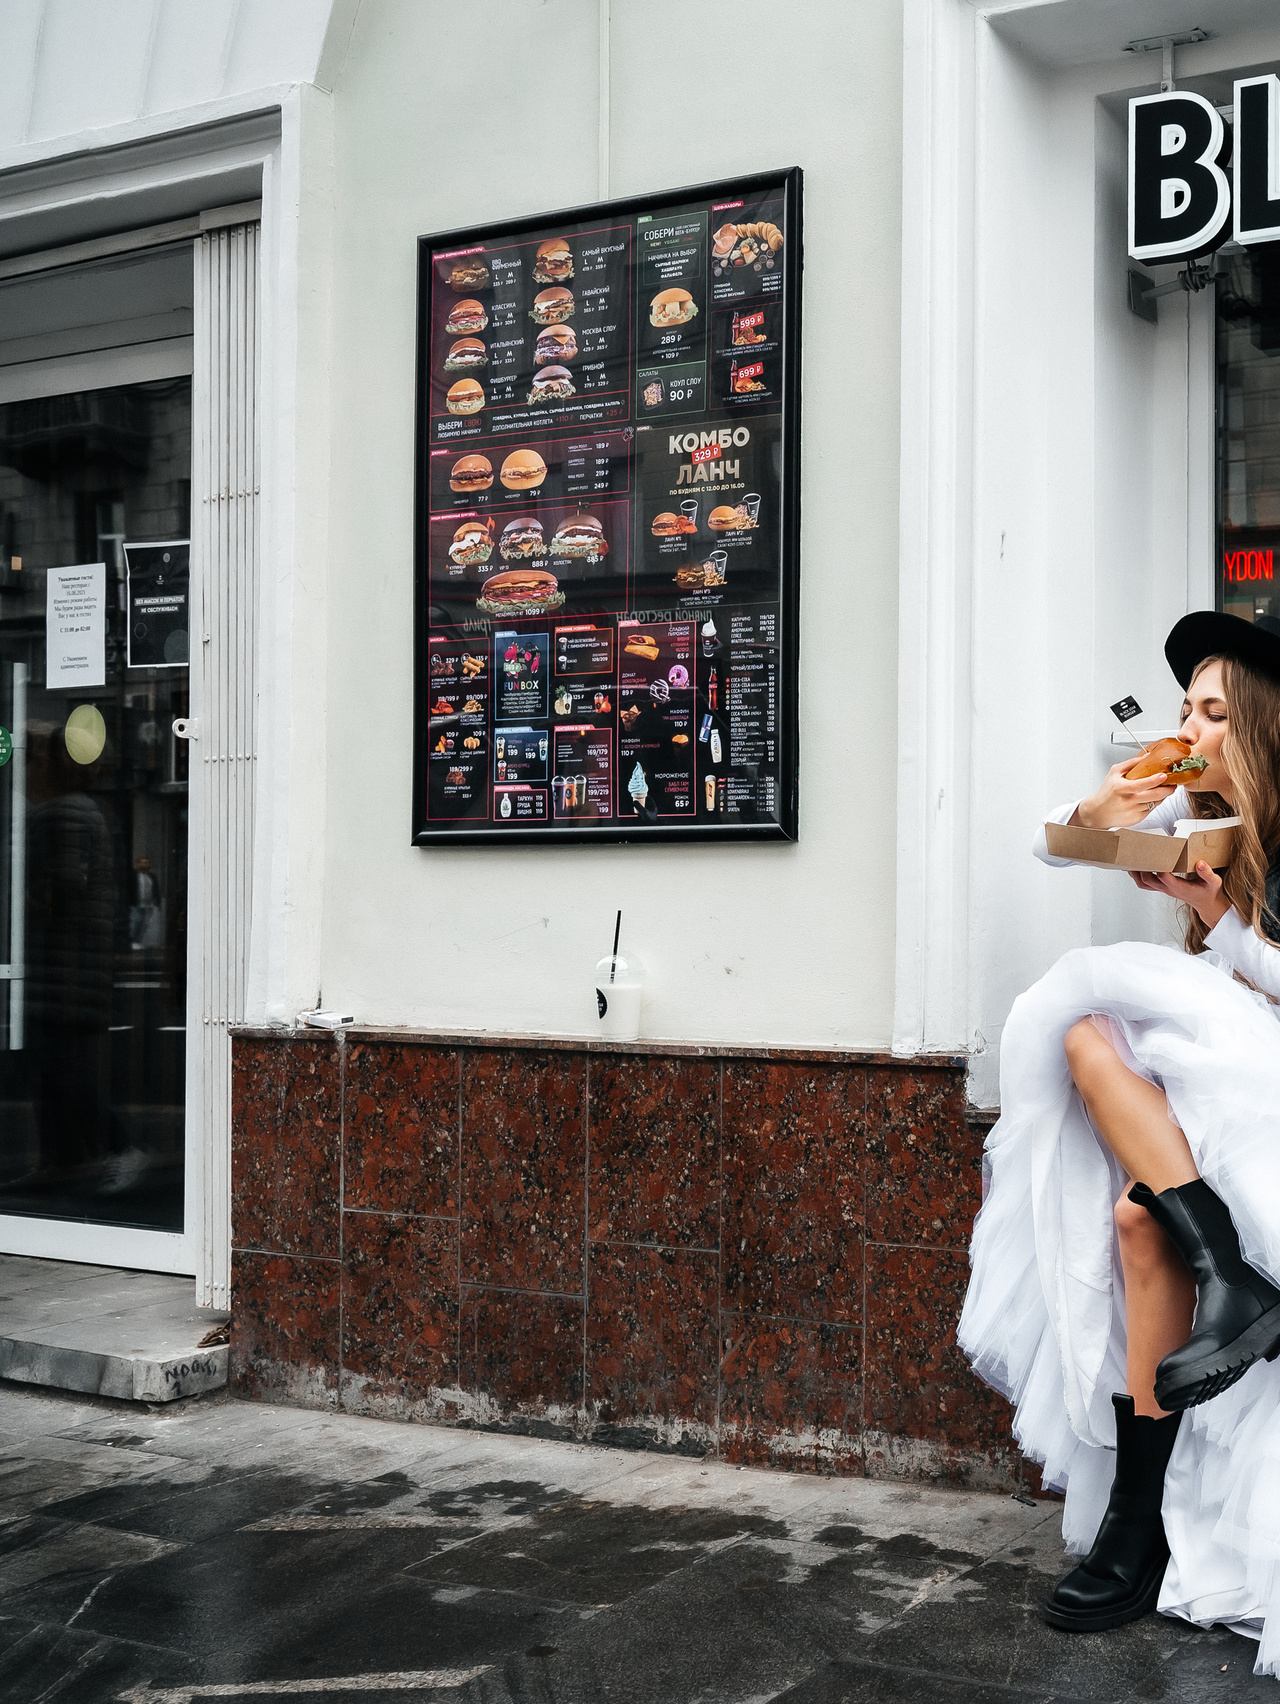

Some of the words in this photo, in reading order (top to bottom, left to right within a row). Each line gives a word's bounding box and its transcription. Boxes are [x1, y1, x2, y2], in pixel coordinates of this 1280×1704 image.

[644, 227, 674, 241] СОБЕРИ
[648, 252, 671, 261] НАЧИНКА
[740, 317, 755, 329] 599
[582, 327, 602, 336] МОСКВА
[661, 335, 676, 345] 289
[639, 370, 659, 378] САЛАТЫ
[739, 367, 755, 379] 699
[669, 380, 686, 388] КОУЛ
[686, 377, 702, 386] СЛОУ
[669, 389, 684, 402] 90
[438, 420, 463, 431] ВЫБЕРИ
[668, 426, 750, 455] КОМБО
[694, 448, 711, 462] 329
[676, 459, 740, 485] ЛАНЧ
[678, 486, 701, 495] БУДНЯМ
[1223, 550, 1273, 581] YDONI
[504, 681, 520, 691] FUN
[520, 680, 539, 690] BOX
[675, 800, 685, 808] 65
